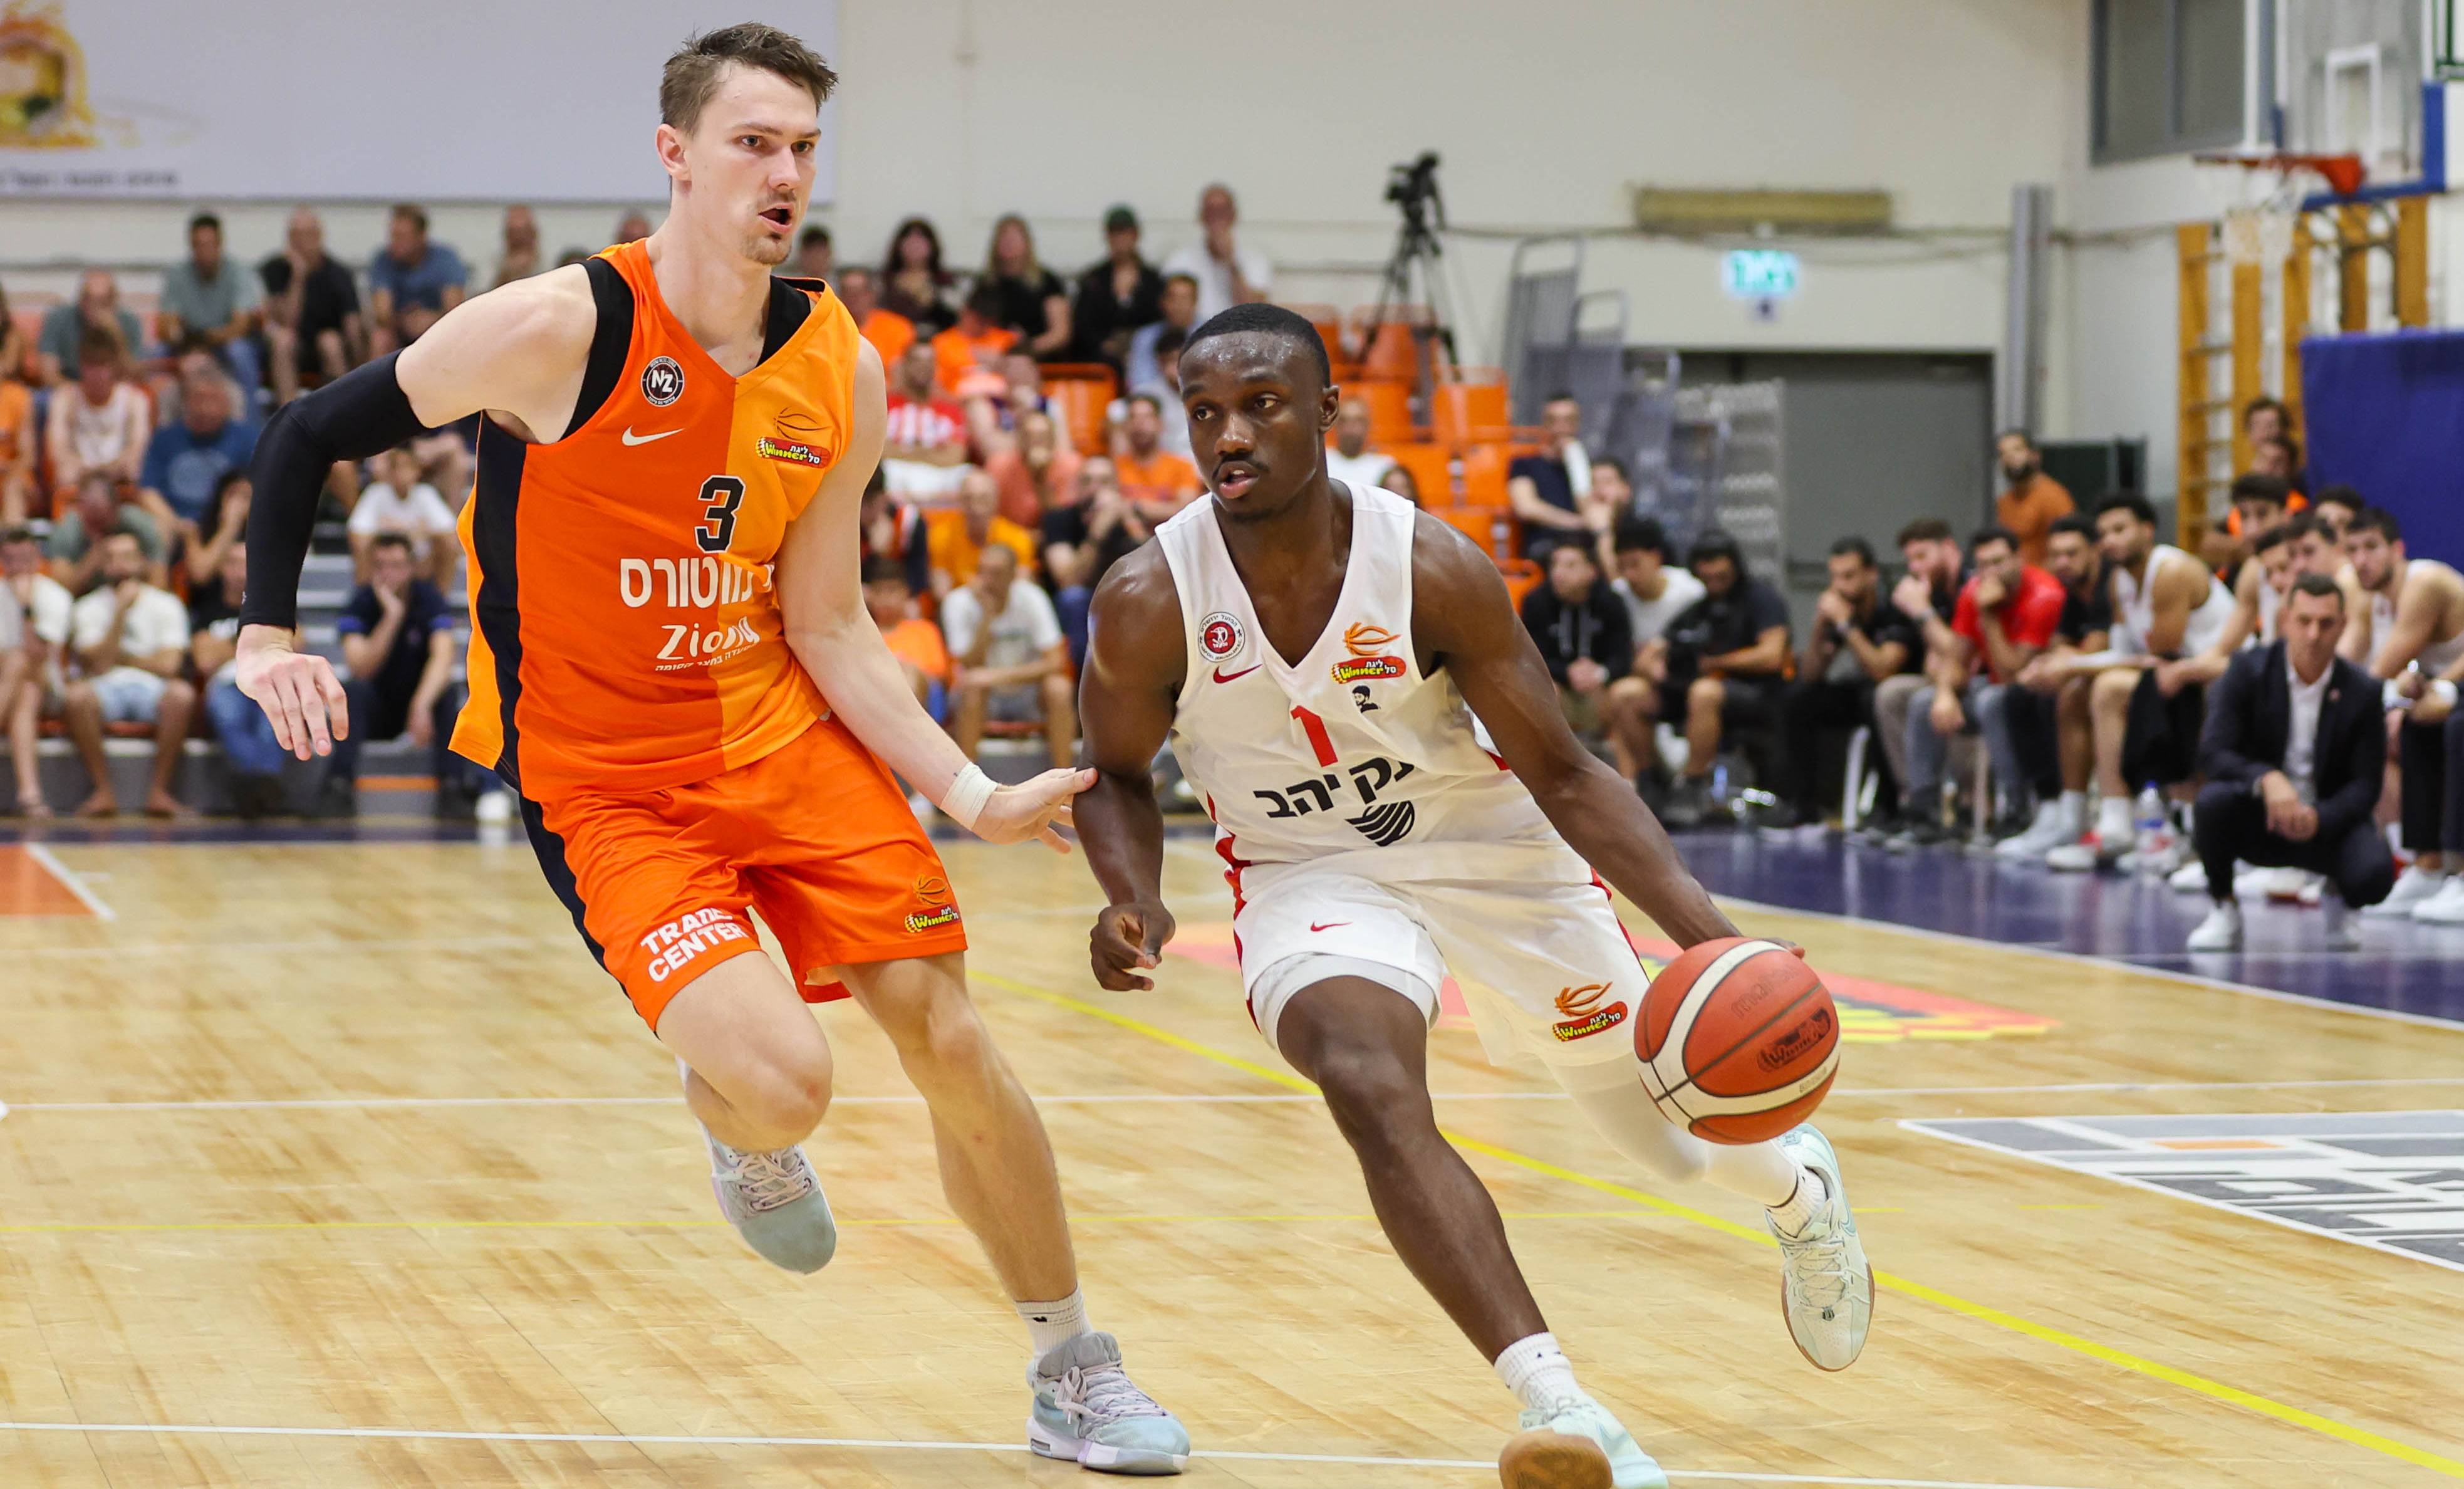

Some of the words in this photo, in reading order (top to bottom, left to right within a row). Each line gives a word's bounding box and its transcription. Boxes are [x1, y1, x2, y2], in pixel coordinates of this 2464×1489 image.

[652, 370, 673, 392] NZ
[765, 442, 808, 461] Winner
[808, 453, 820, 464] סל
[790, 446, 808, 454] ליגת
[694, 474, 746, 554] 3
[1340, 667, 1383, 679] Winner
[1384, 665, 1396, 674] סל
[1366, 659, 1383, 668] ליגת
[1291, 705, 1338, 768] 1
[1253, 774, 1341, 818] יהב
[640, 907, 733, 954] TRADE
[914, 914, 952, 928] Winner
[648, 922, 749, 982] CENTER
[1560, 1018, 1609, 1037] Winner
[1608, 1013, 1621, 1022] סל
